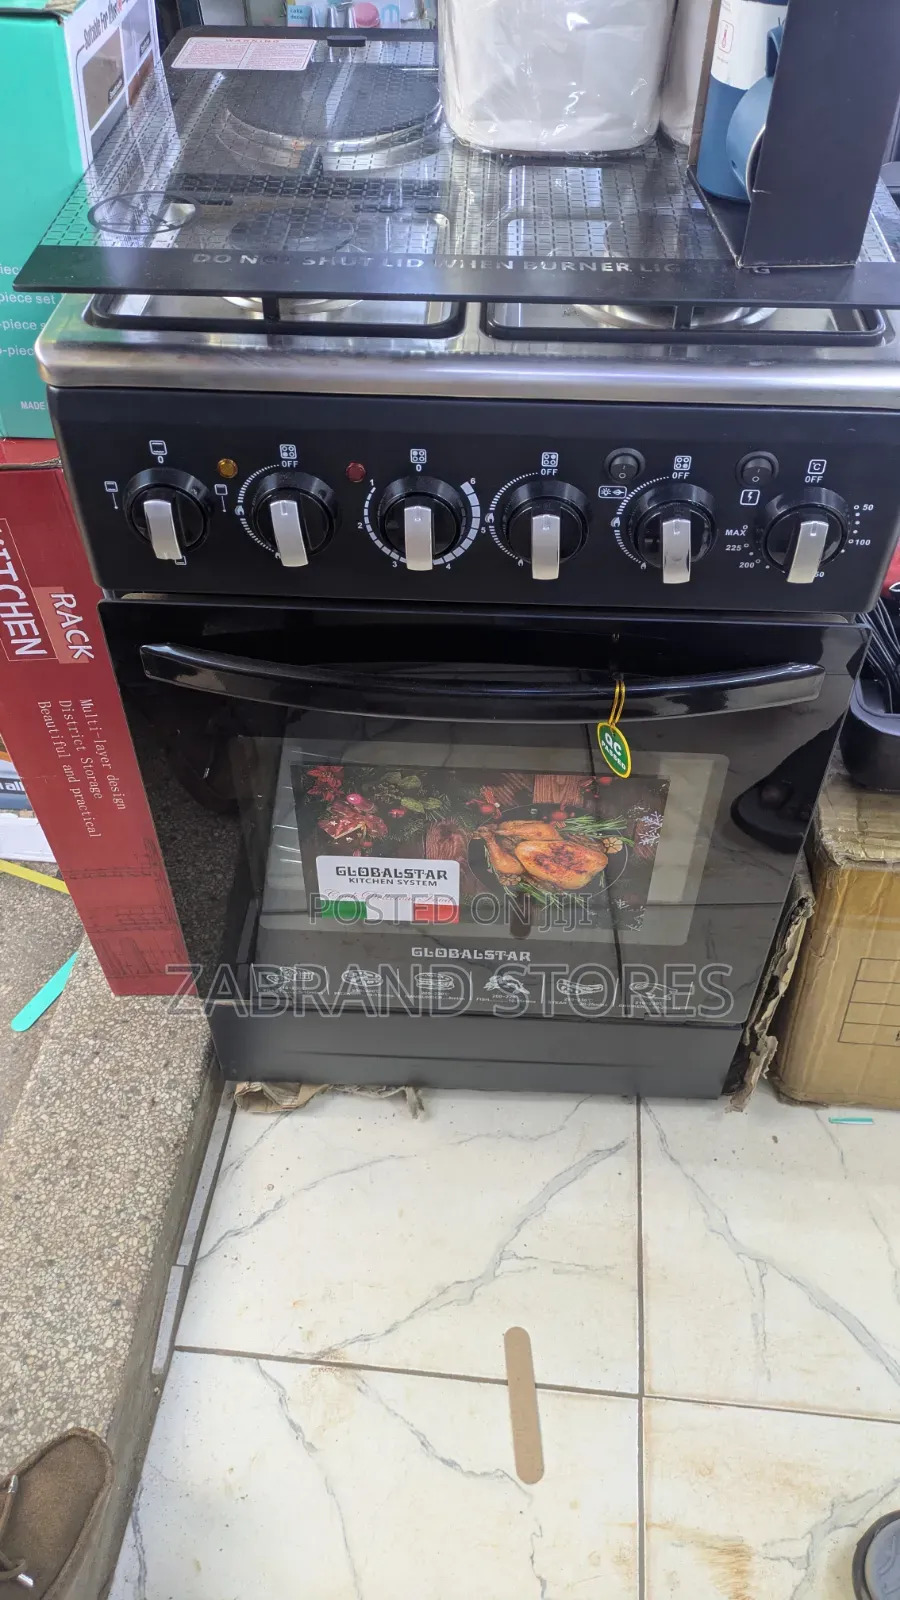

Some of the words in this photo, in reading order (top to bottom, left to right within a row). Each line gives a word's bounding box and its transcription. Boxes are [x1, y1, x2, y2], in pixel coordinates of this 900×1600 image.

[192, 253, 232, 264] DO
[302, 256, 375, 267] SHUT
[384, 257, 425, 268] LID
[523, 260, 631, 272] BURNER
[36, 294, 56, 304] set
[0, 345, 35, 357] -piec
[20, 401, 46, 410] MADE
[281, 460, 299, 468] OFF
[540, 468, 558, 476] OFF
[671, 471, 691, 480] OFF
[470, 477, 476, 485] 6
[804, 475, 824, 484] OFF
[862, 503, 874, 511] 50
[480, 526, 486, 534] 5
[725, 529, 746, 537] MAX
[391, 560, 398, 568] 3
[739, 561, 755, 569] 200
[50, 593, 95, 660] RACK
[37, 701, 71, 759] Beautiful
[605, 732, 622, 756] QC
[58, 700, 87, 752] District
[80, 757, 103, 799] Storage
[80, 699, 113, 769] Multi-layer
[107, 774, 126, 811] design
[62, 764, 80, 784] and
[0, 781, 25, 792] all
[70, 788, 102, 838] practical
[335, 866, 448, 880] GLOBALSTAR
[348, 877, 394, 885] KITCHEN
[397, 879, 438, 887] SYSTEM
[411, 946, 531, 962] GLOBALSTAR
